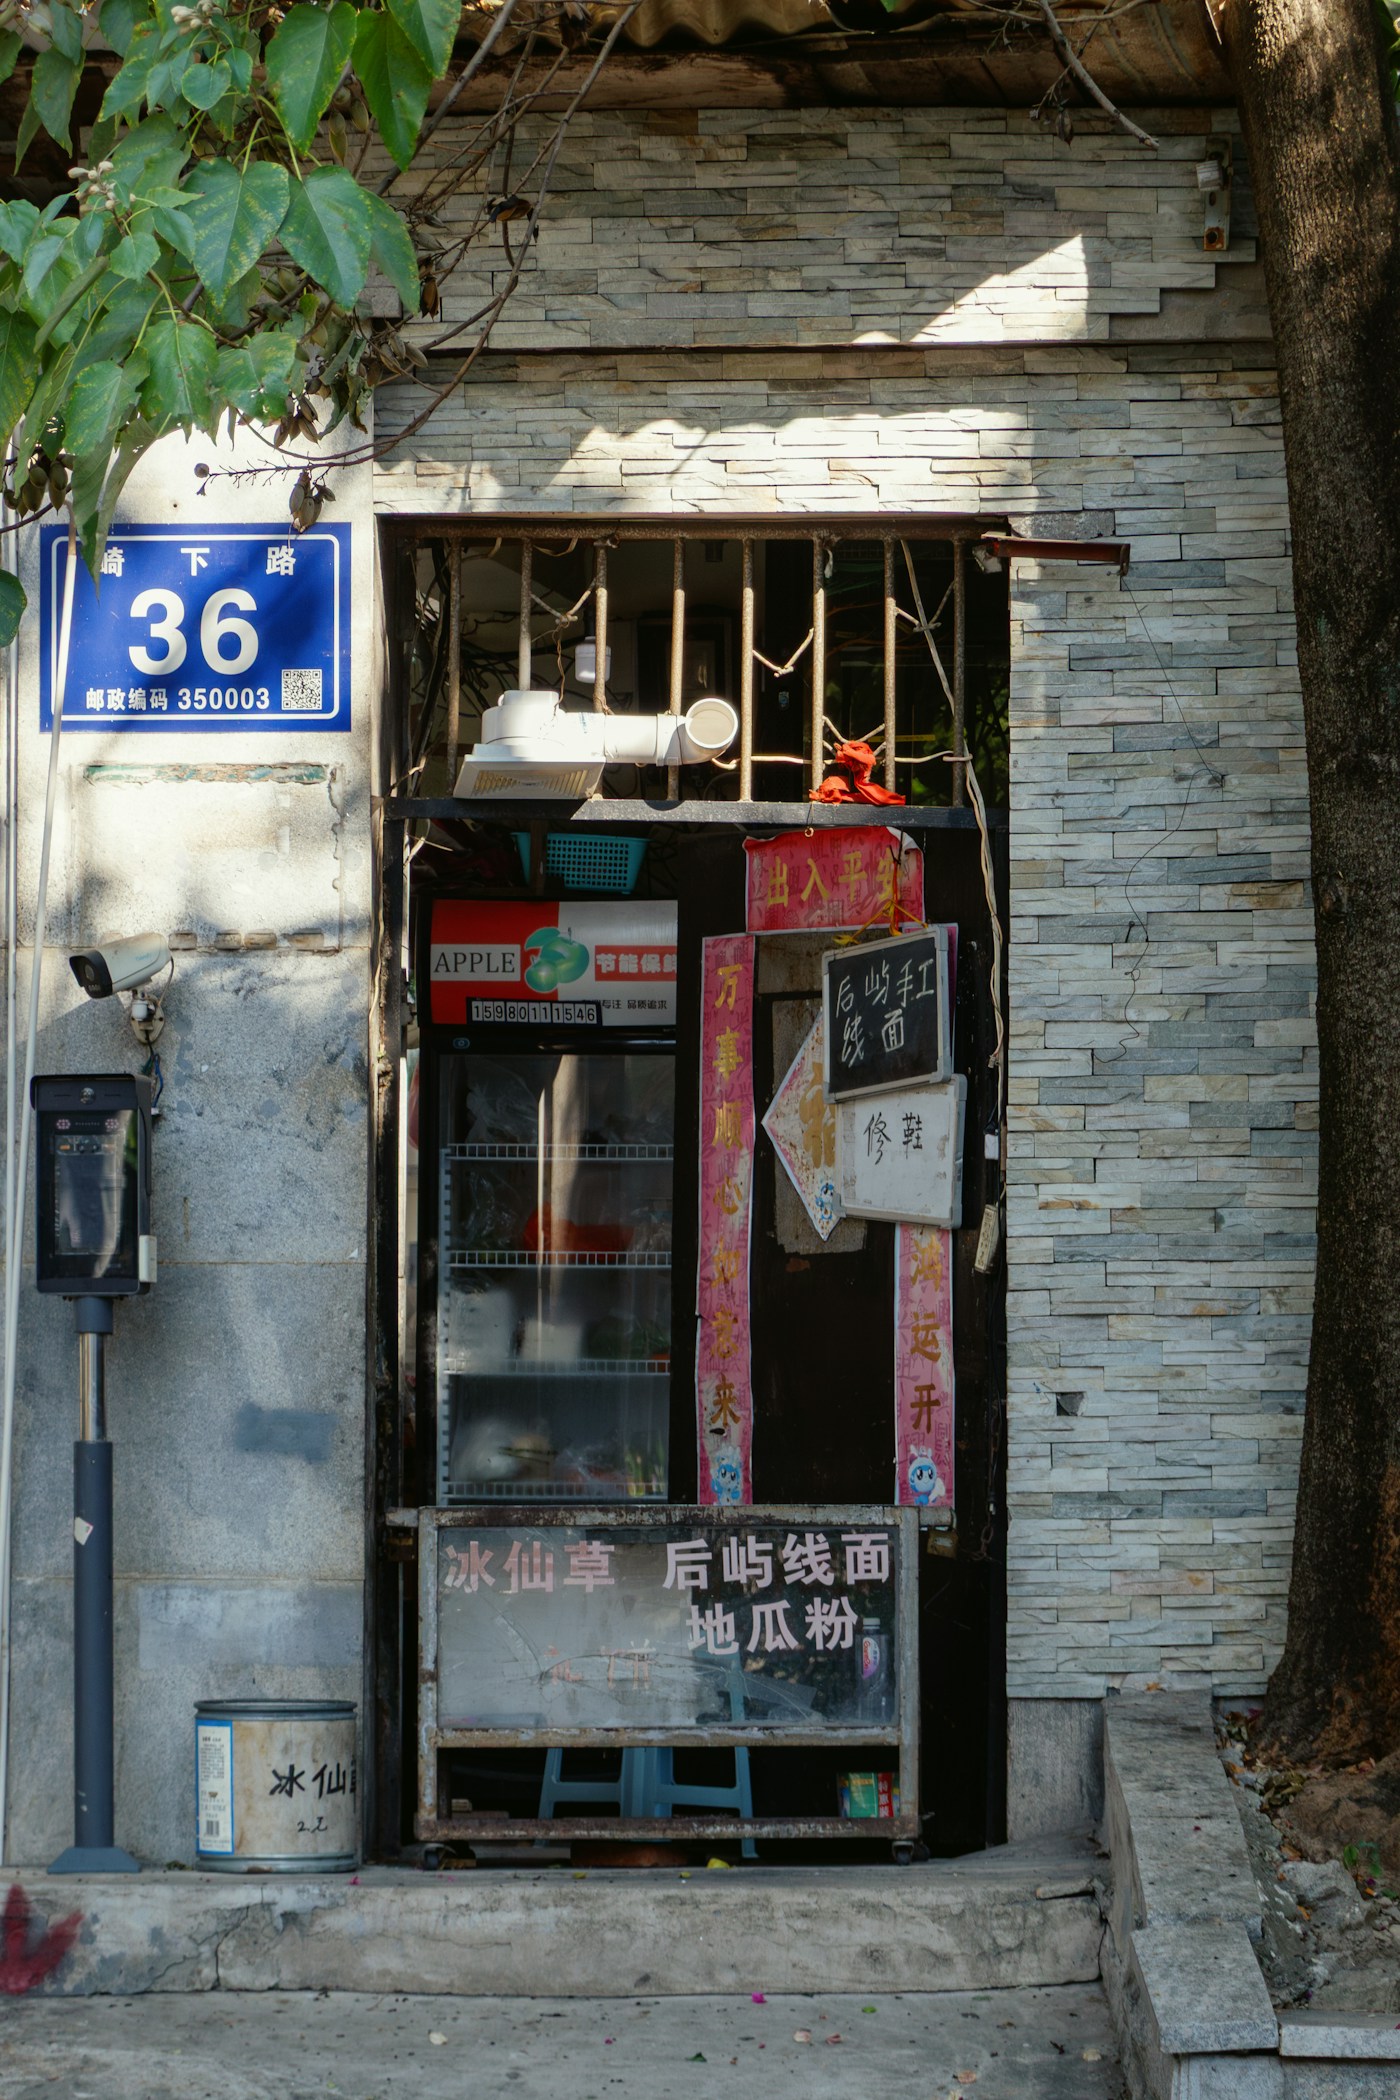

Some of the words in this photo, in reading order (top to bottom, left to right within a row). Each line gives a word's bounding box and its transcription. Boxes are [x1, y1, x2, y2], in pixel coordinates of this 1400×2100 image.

[99, 546, 297, 577] 崎下路
[128, 588, 259, 676] 36
[86, 688, 168, 712] 邮政编码
[177, 687, 270, 710] 350003
[766, 847, 904, 908] 出入平安
[433, 951, 516, 974] APPLE
[835, 958, 935, 1019] 后屿手工
[473, 1002, 596, 1022] 15980111546
[841, 1008, 905, 1068] 线面
[863, 1111, 923, 1165] 修鞋
[711, 963, 743, 1428] 万事顺心如意来
[444, 1540, 615, 1594] 冰仙草
[662, 1532, 890, 1591] 后屿线面
[686, 1596, 858, 1656] 地瓜粉
